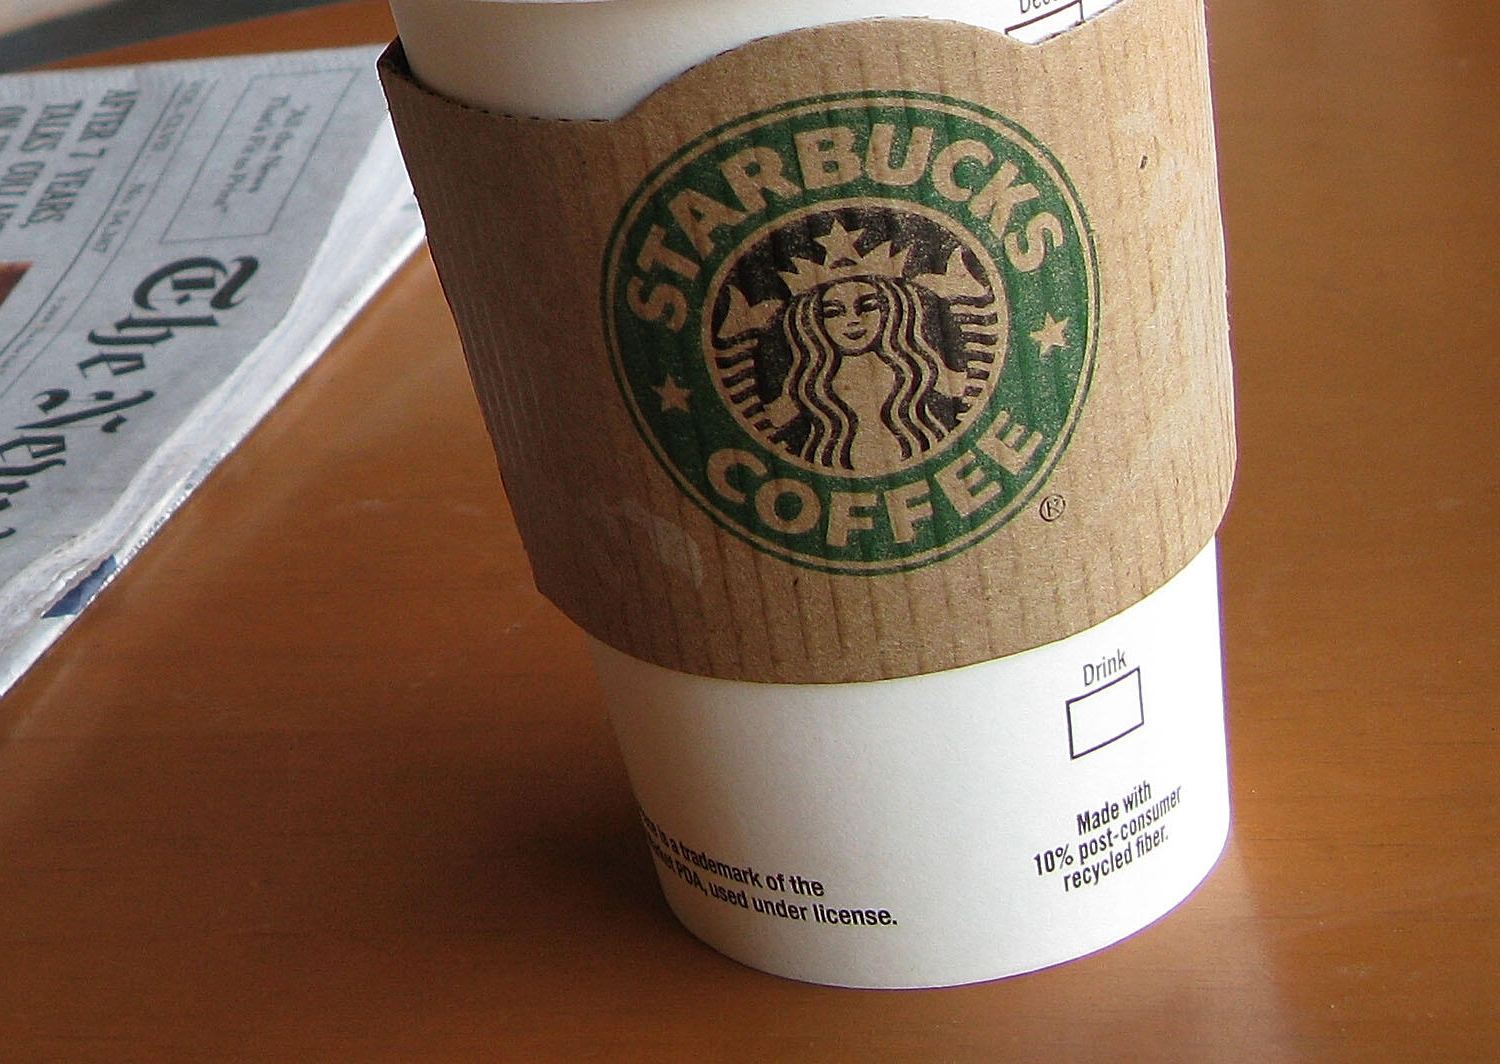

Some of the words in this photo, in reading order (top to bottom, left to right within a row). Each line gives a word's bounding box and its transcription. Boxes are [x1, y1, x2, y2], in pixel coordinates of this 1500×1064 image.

[18, 99, 84, 154] TALKS
[78, 90, 140, 141] AFTER
[69, 147, 110, 160] 7
[18, 168, 95, 229] YEARS,
[626, 122, 1064, 334] STARBUCKS
[77, 256, 260, 378] The
[706, 408, 1043, 548] COFFEE
[1082, 647, 1127, 688] Drink
[1033, 843, 1074, 876] 10%
[1078, 785, 1182, 866] post-consumer
[1076, 800, 1119, 837] Made
[1123, 780, 1152, 814] with
[670, 838, 679, 854] a
[678, 840, 764, 889] trademark
[765, 873, 786, 892] of
[788, 875, 826, 897] the
[1063, 845, 1133, 893] recycled
[1136, 823, 1169, 862] fiber.
[675, 860, 708, 896] PDA,
[708, 881, 750, 910] used
[751, 895, 808, 922] under
[812, 903, 899, 927] license.
